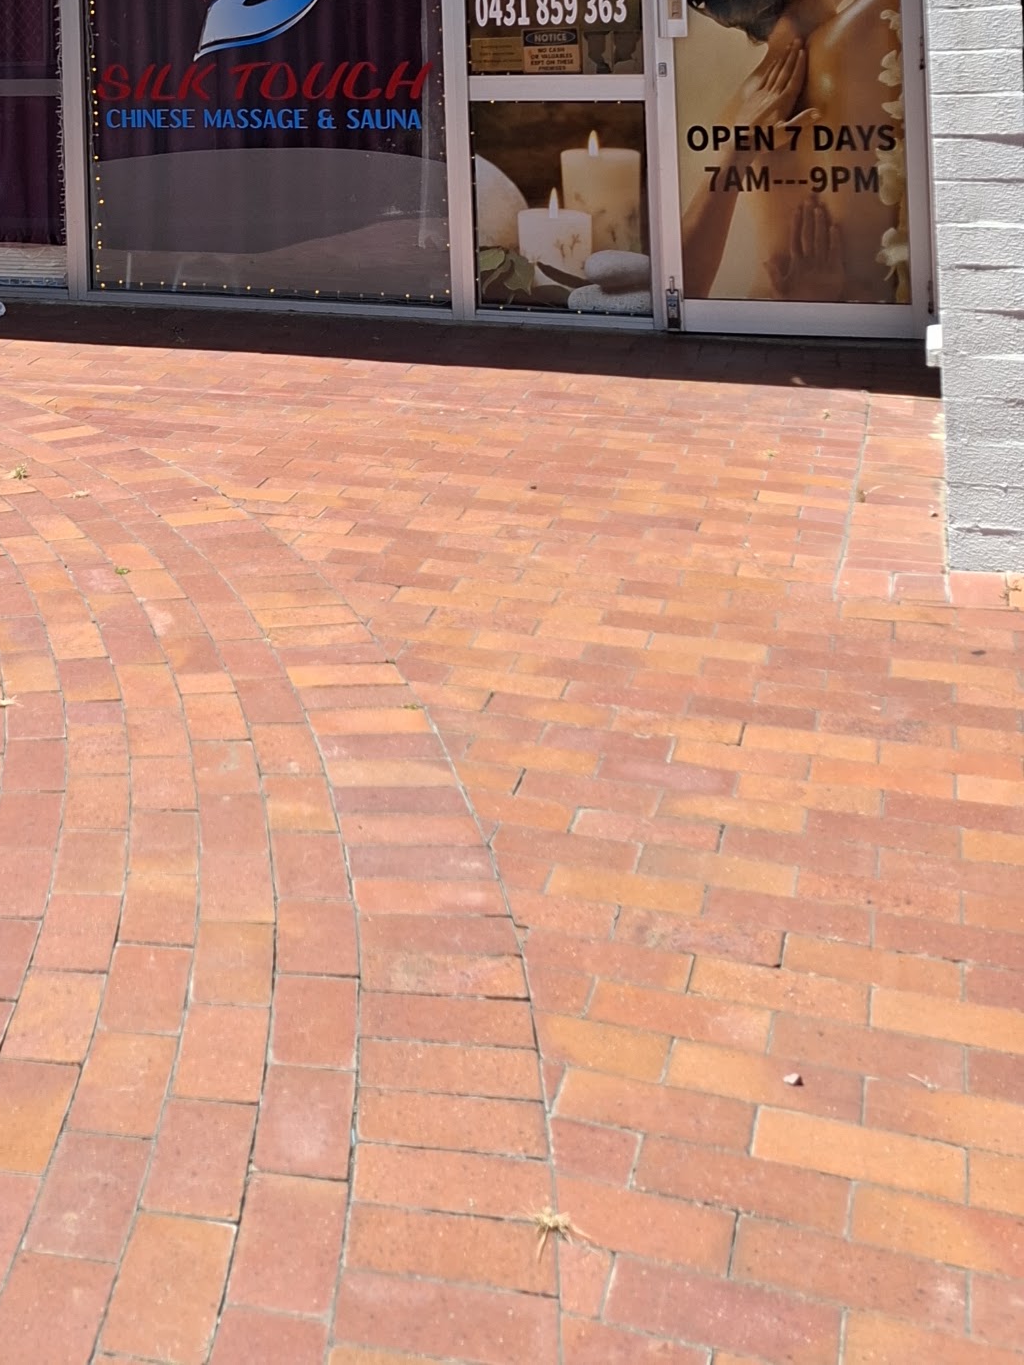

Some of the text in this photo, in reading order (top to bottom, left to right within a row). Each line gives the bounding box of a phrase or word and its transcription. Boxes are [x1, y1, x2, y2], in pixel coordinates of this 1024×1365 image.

[534, 33, 567, 43] NOTICE
[97, 60, 433, 101] SILK TOUCH
[106, 108, 422, 129] CHINESE MASSAGE & SAUNA
[686, 124, 897, 152] OPEN 7 DAYS
[704, 165, 879, 193] 7AM---9PM
